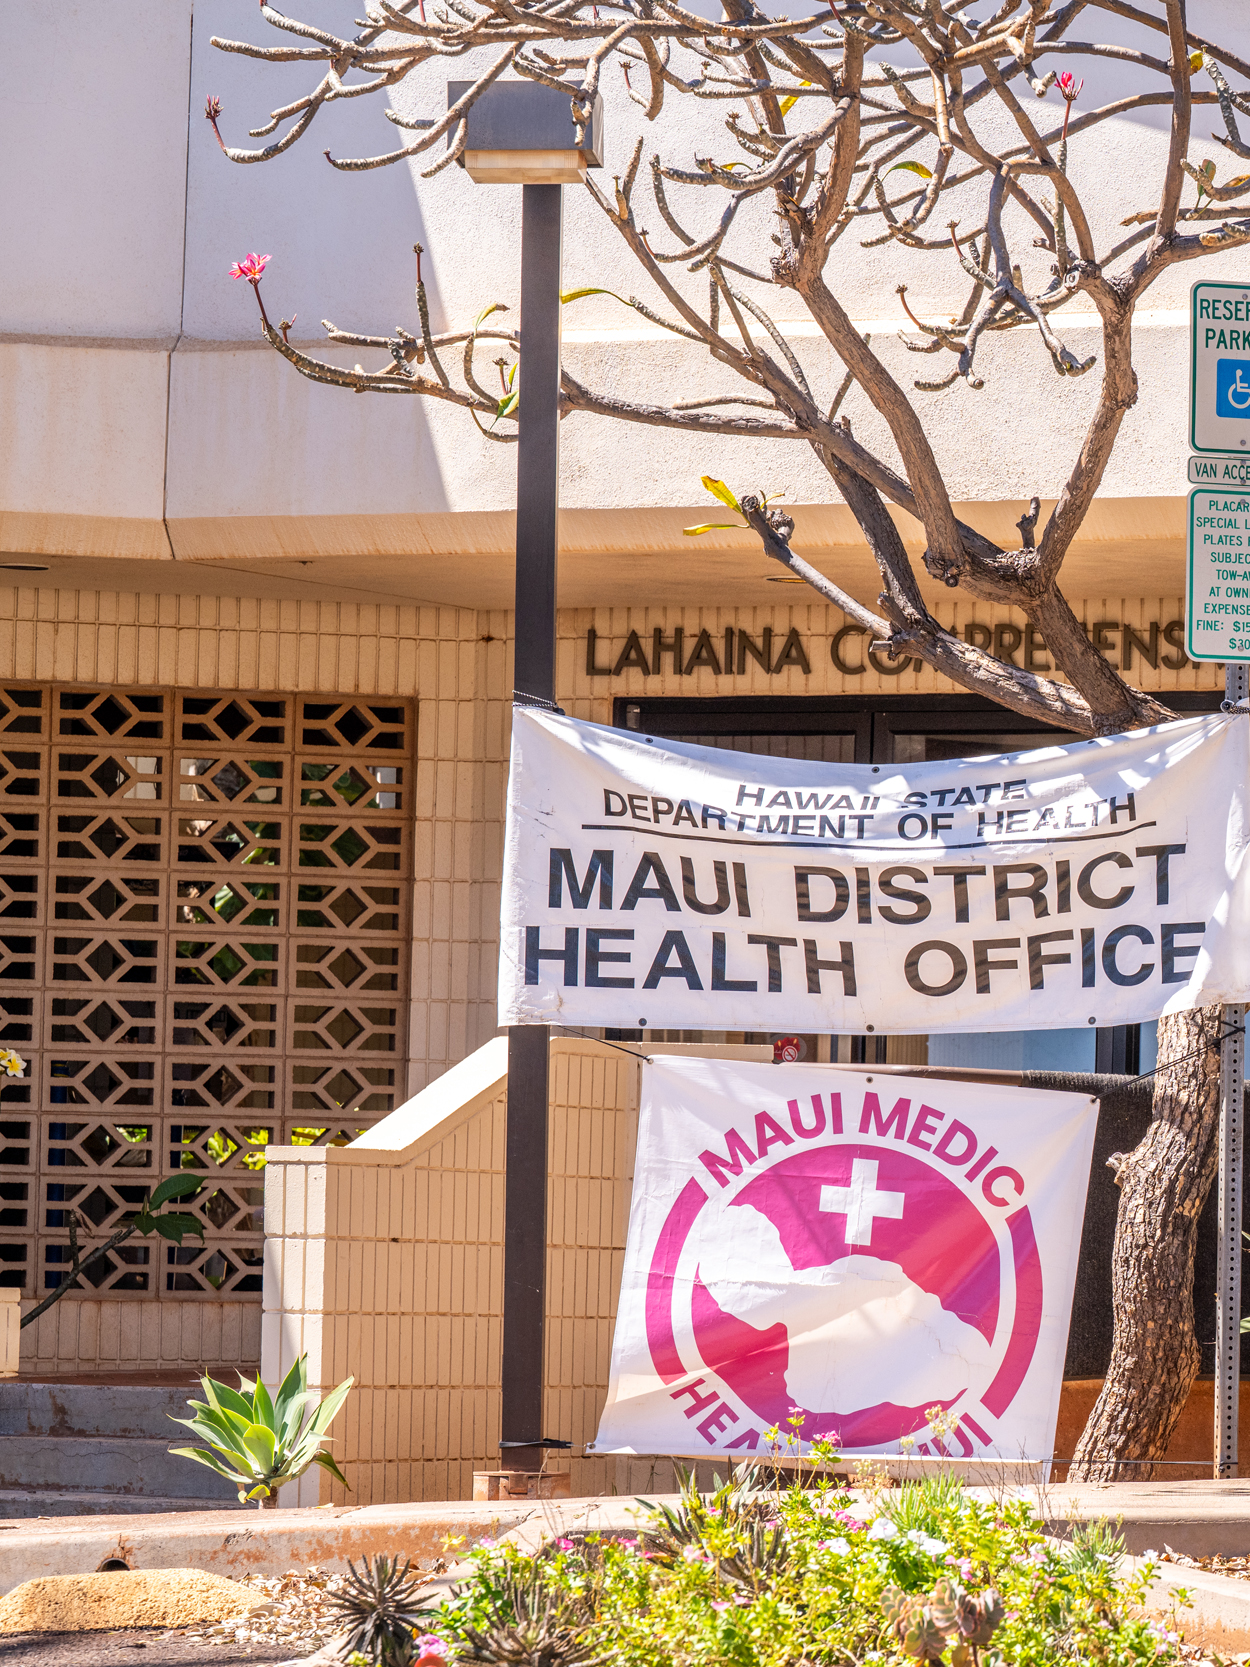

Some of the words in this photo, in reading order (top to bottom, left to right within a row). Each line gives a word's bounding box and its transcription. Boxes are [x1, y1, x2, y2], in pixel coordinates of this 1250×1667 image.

[1194, 462, 1218, 479] VAN
[1196, 517, 1240, 530] SPECIAL
[1203, 534, 1243, 546] PLATES
[1208, 586, 1221, 598] AT
[1196, 619, 1224, 632] FINE:
[585, 626, 811, 677] LAHAINA
[735, 784, 881, 811] HAWAII
[901, 778, 1027, 808] STATE
[603, 787, 875, 841] DEPARTMENT
[897, 812, 955, 842] OF
[975, 792, 1137, 838] HEALTH
[547, 846, 752, 918] MAUI
[794, 843, 1187, 926] DISTRICT
[522, 925, 858, 997] HEALTH
[903, 921, 1207, 997] OFFICE
[697, 1091, 844, 1189] MAUI
[858, 1090, 1026, 1209] MEDIC
